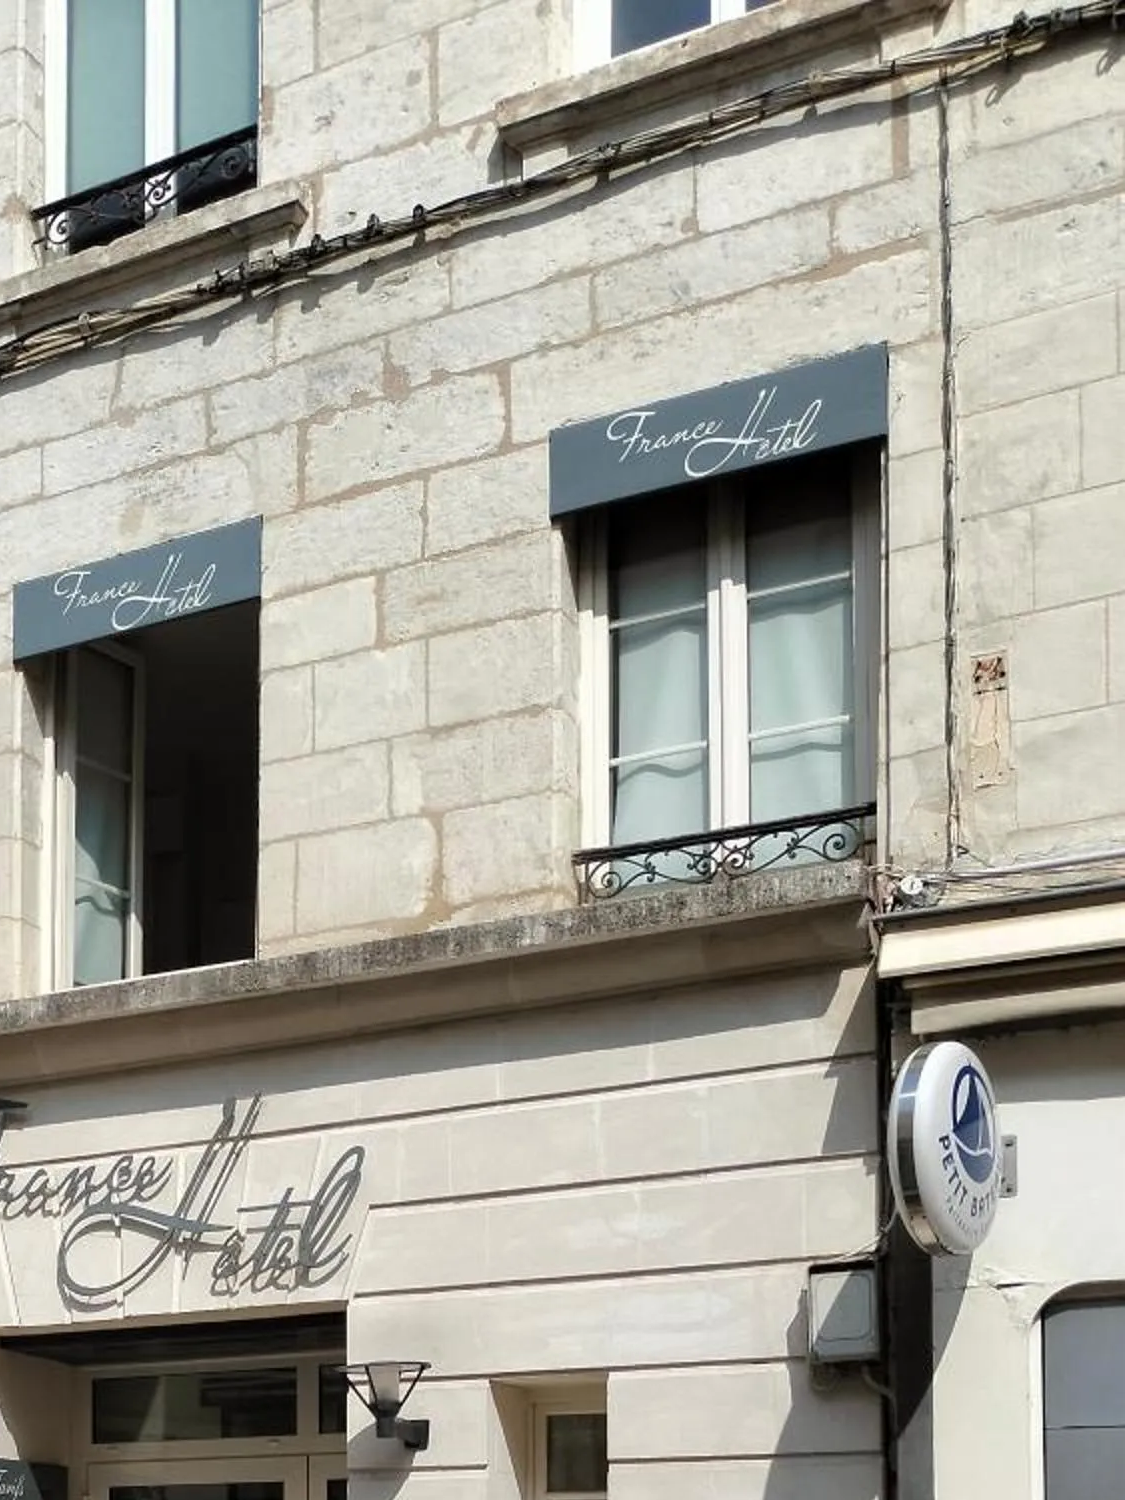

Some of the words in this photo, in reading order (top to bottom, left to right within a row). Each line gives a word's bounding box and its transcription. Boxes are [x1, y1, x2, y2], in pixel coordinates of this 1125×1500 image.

[606, 411, 723, 462] France
[54, 570, 142, 616] France
[938, 1134, 968, 1206] PETIT
